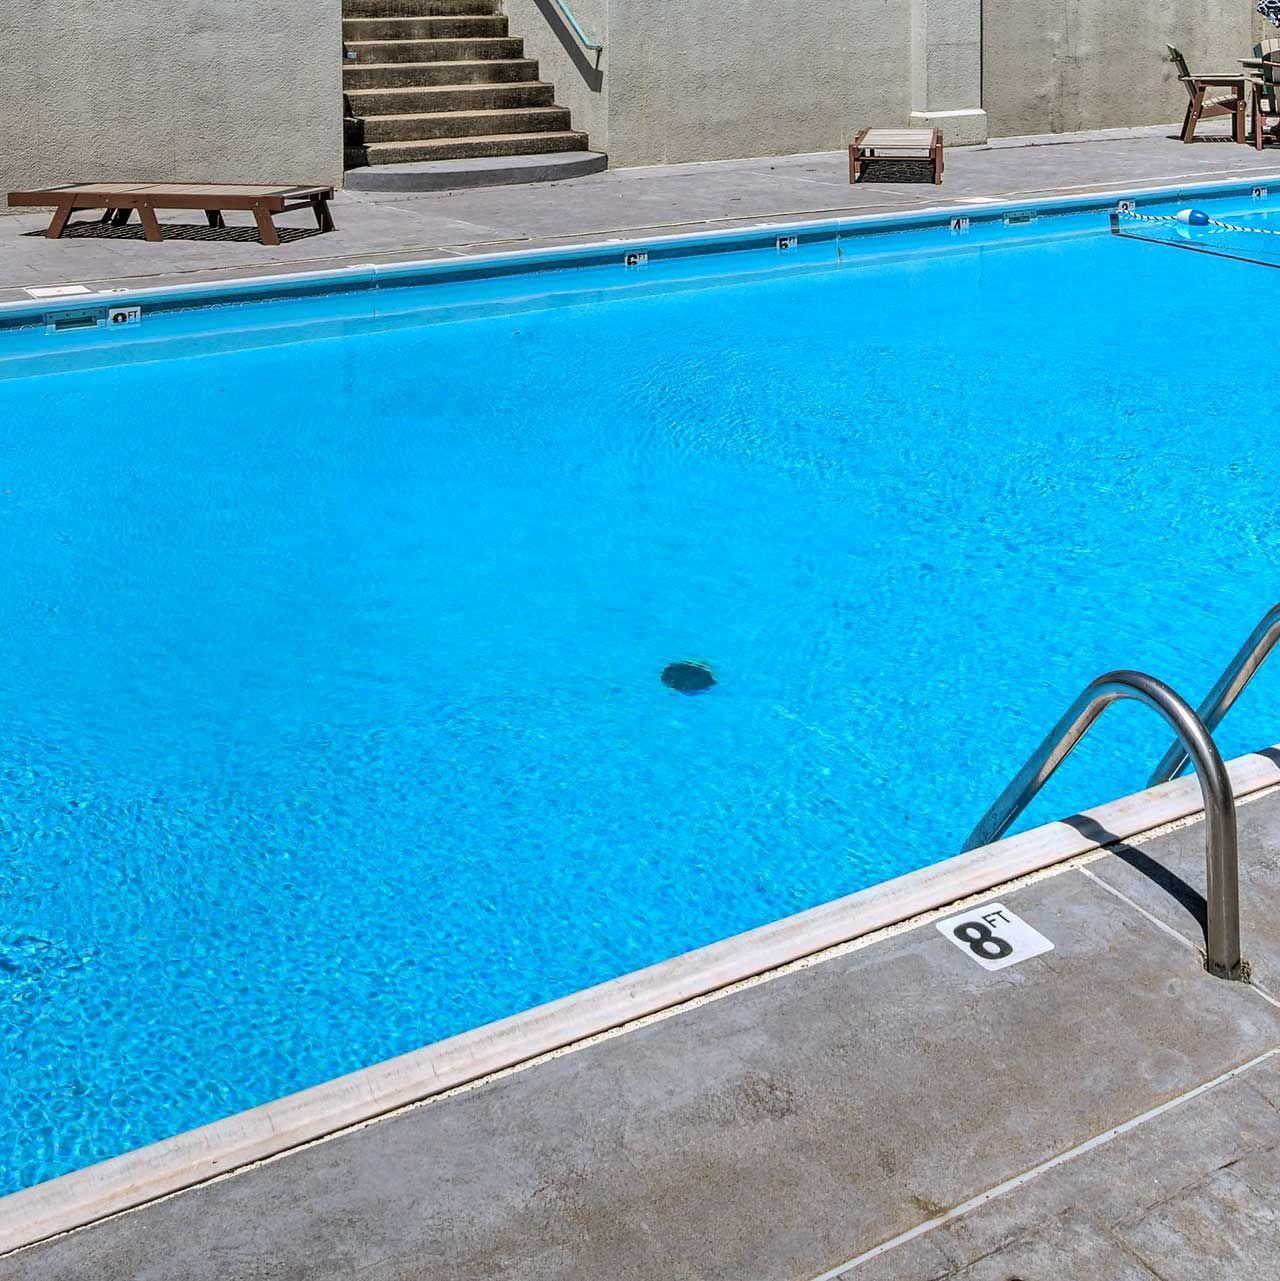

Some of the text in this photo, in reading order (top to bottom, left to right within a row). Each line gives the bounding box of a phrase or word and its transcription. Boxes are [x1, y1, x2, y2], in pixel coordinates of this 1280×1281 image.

[779, 237, 788, 248] 5
[627, 254, 638, 266] 6
[128, 310, 138, 319] FT
[953, 910, 1014, 960] 8 FT
